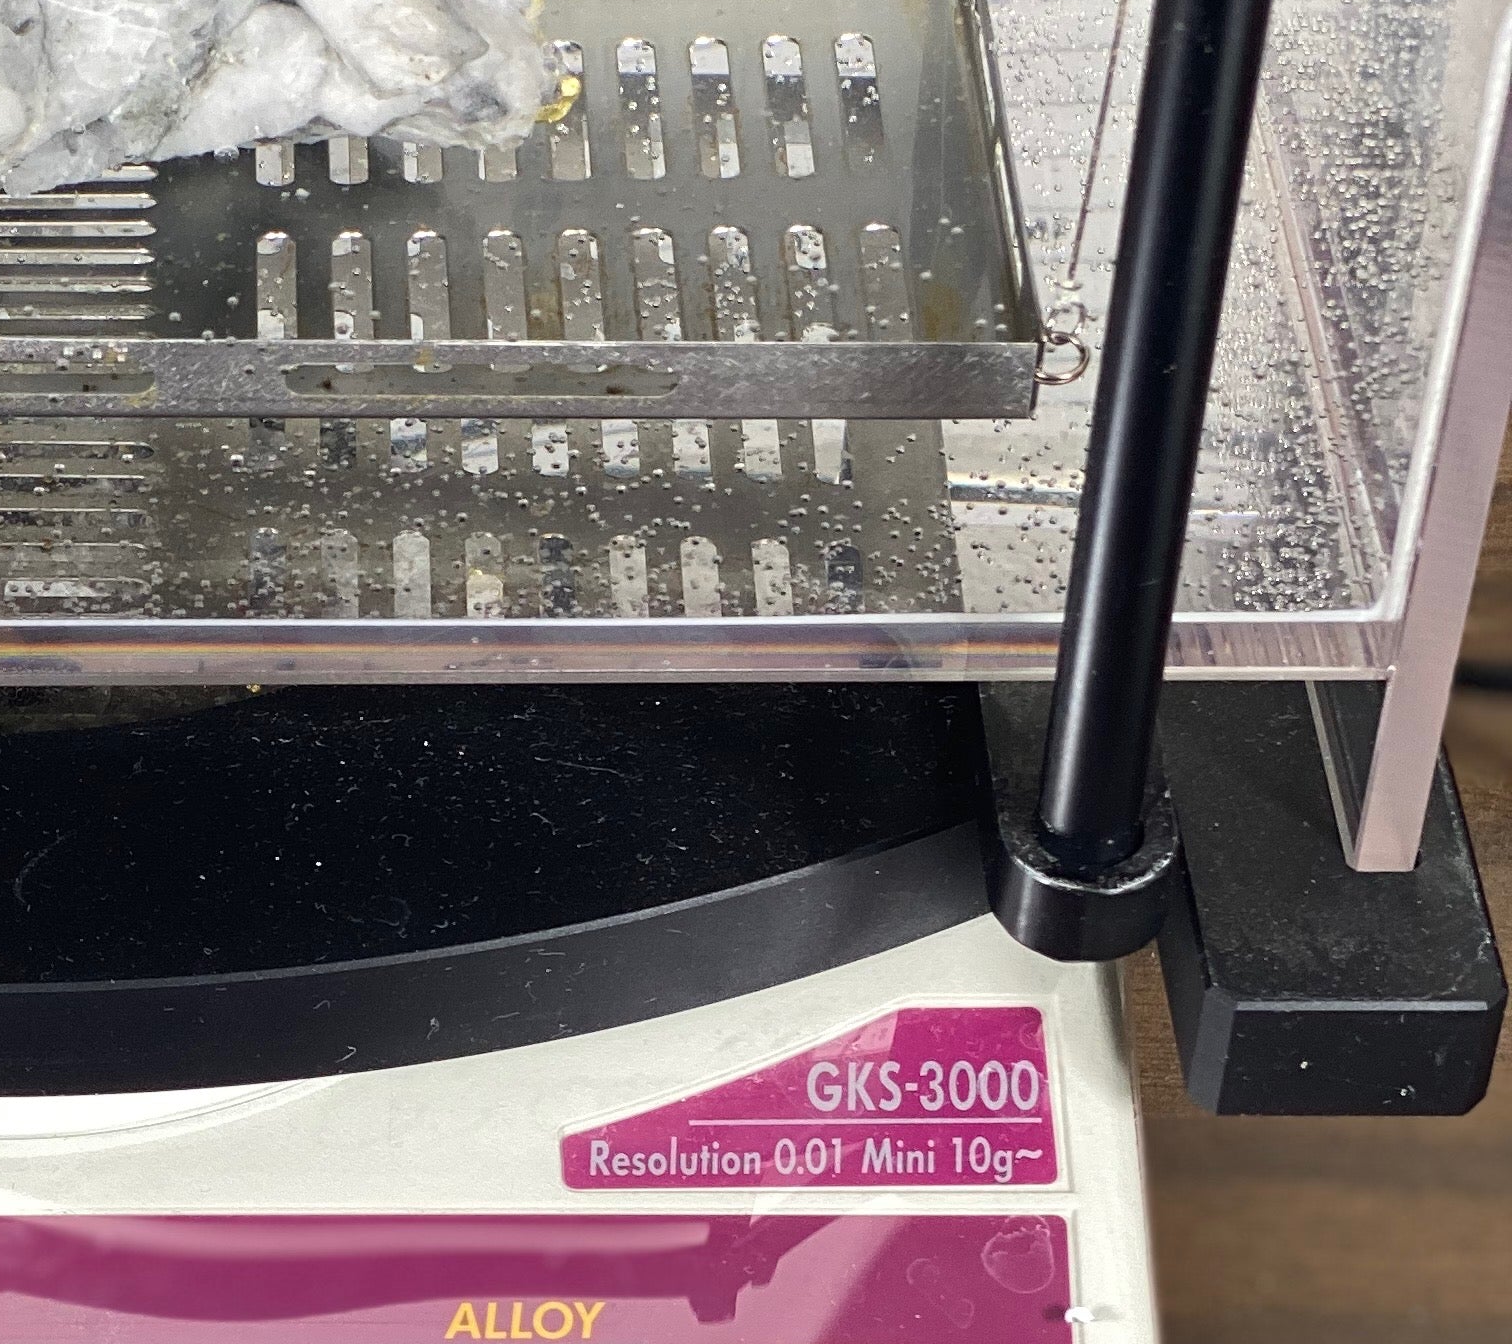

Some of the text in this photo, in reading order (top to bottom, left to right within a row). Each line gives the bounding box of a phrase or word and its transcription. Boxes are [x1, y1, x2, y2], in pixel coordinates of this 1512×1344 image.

[807, 1060, 1041, 1113] GKS-3000
[589, 1137, 763, 1177] Resolution
[773, 1137, 843, 1175] 0.01
[861, 1138, 936, 1174] Mini
[444, 1300, 605, 1340] ALLOY
